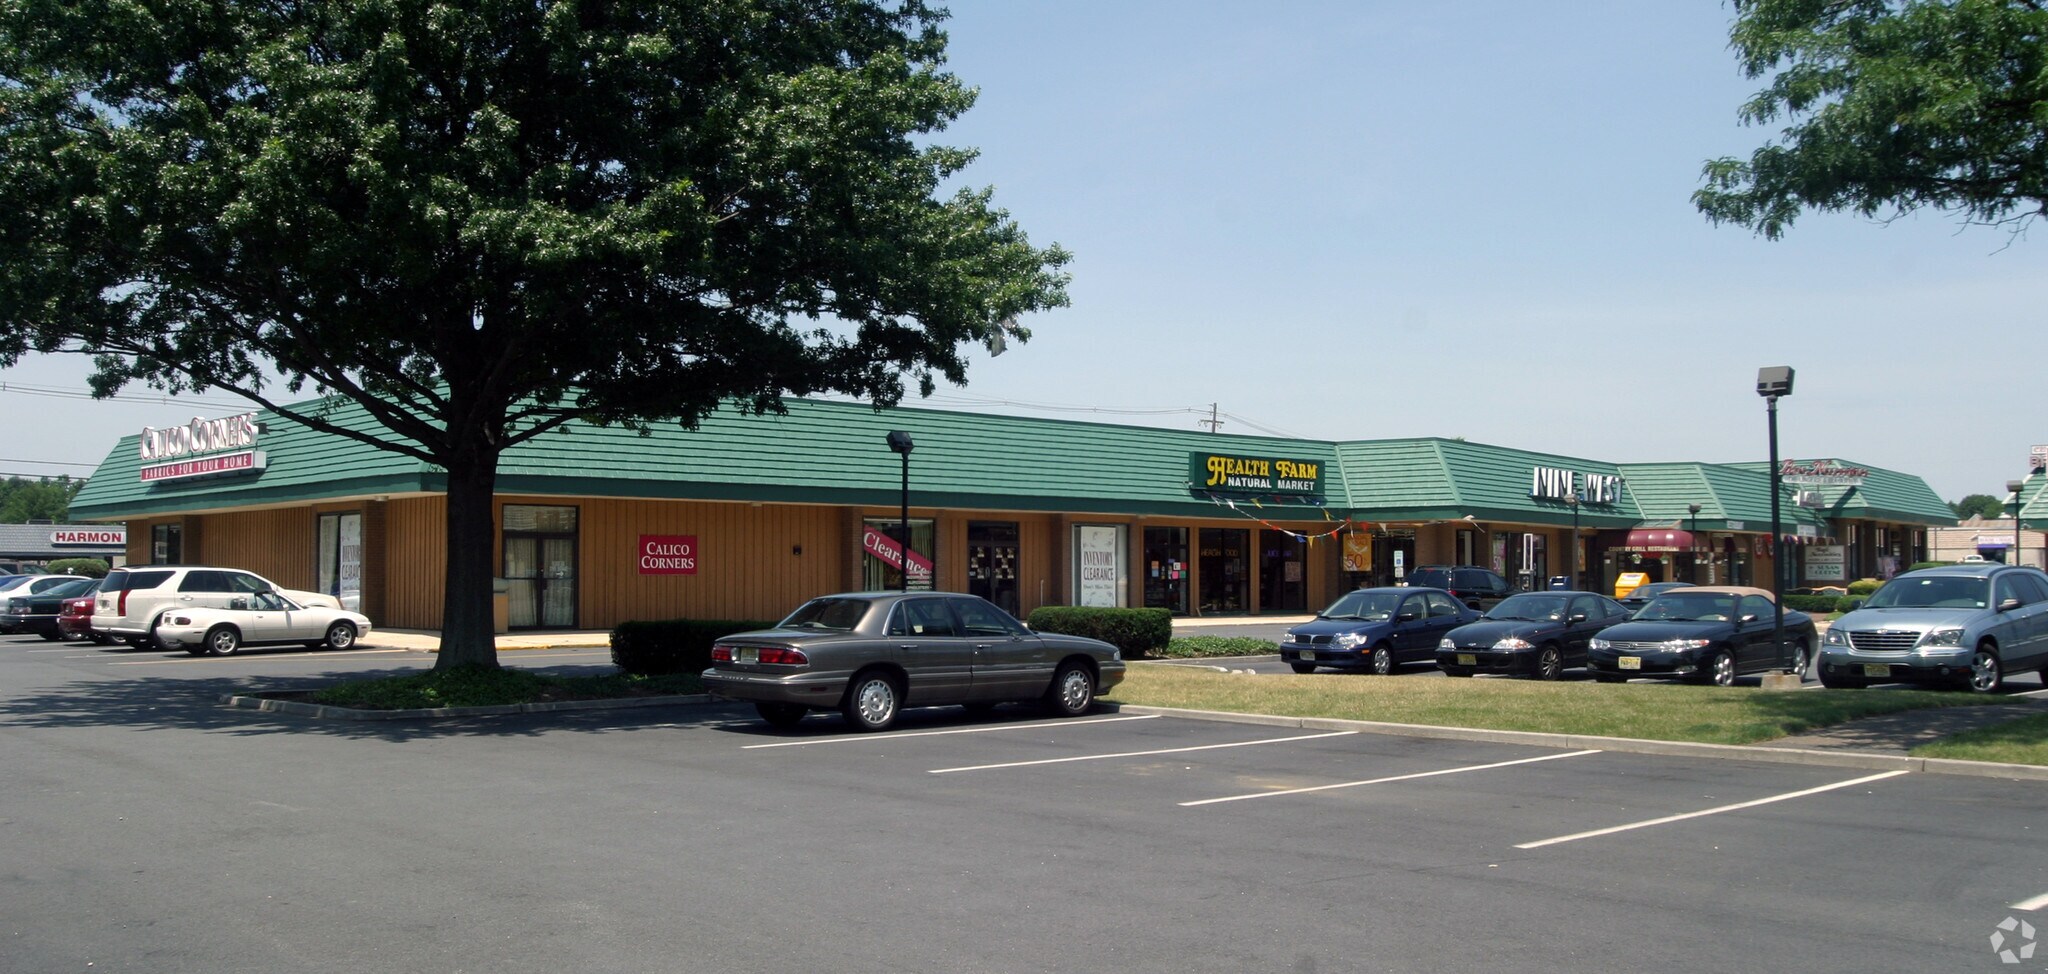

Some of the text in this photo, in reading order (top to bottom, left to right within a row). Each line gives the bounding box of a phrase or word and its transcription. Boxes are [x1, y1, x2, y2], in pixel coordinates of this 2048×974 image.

[141, 413, 258, 460] CALICO CORNERS
[145, 456, 249, 479] FABRICS FOR YOUR HOME
[1207, 456, 1318, 486] HEALTH FARM
[1228, 477, 1315, 491] NATURAL MARKET
[1583, 473, 1625, 507] WEST
[55, 531, 123, 543] HARMON
[646, 541, 690, 556] CALICO
[641, 555, 695, 569] CORNERS
[1083, 551, 1113, 566] INVENTORY
[1083, 567, 1114, 581] CLEARANCE
